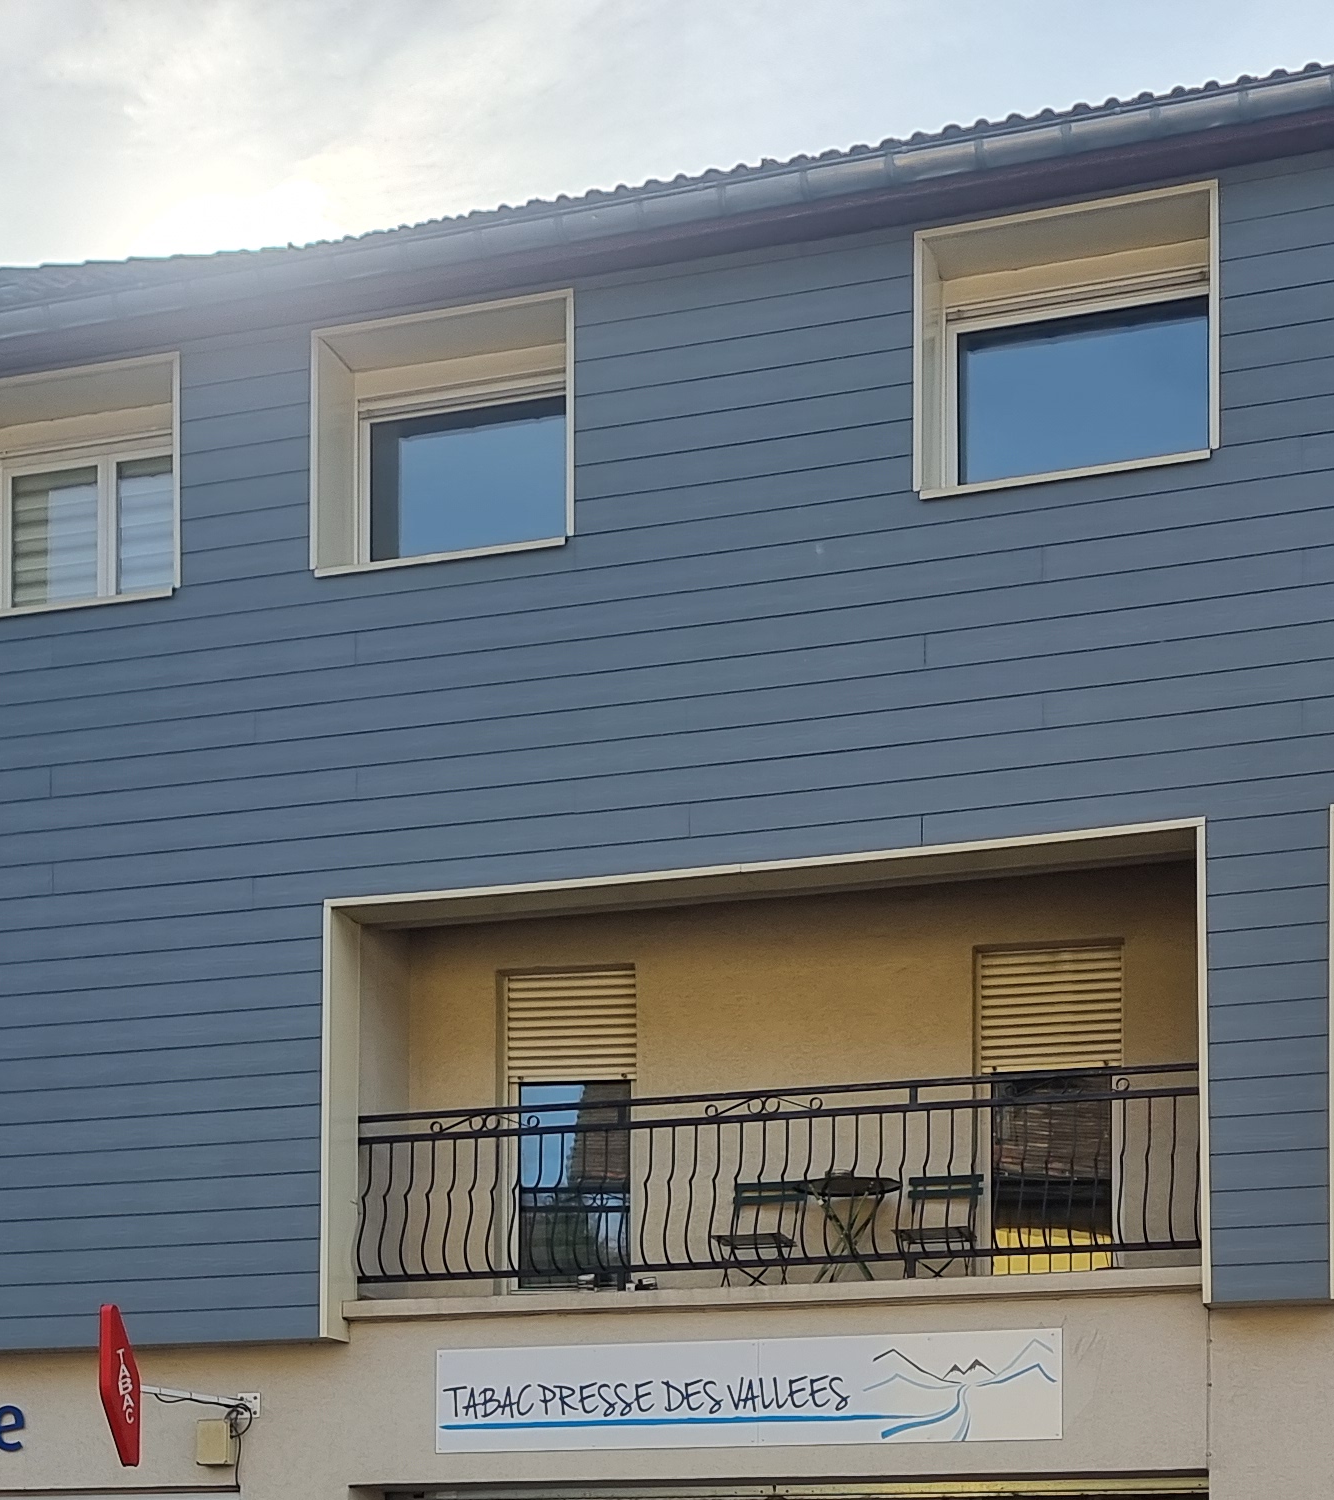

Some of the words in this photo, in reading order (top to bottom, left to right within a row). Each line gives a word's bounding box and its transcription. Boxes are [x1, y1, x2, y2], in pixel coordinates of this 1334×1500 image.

[116, 1347, 135, 1424] TABAC
[442, 1382, 534, 1420] TABAC
[536, 1380, 656, 1418] PRESSE
[660, 1378, 724, 1415] DES
[726, 1374, 851, 1414] VALLEES
